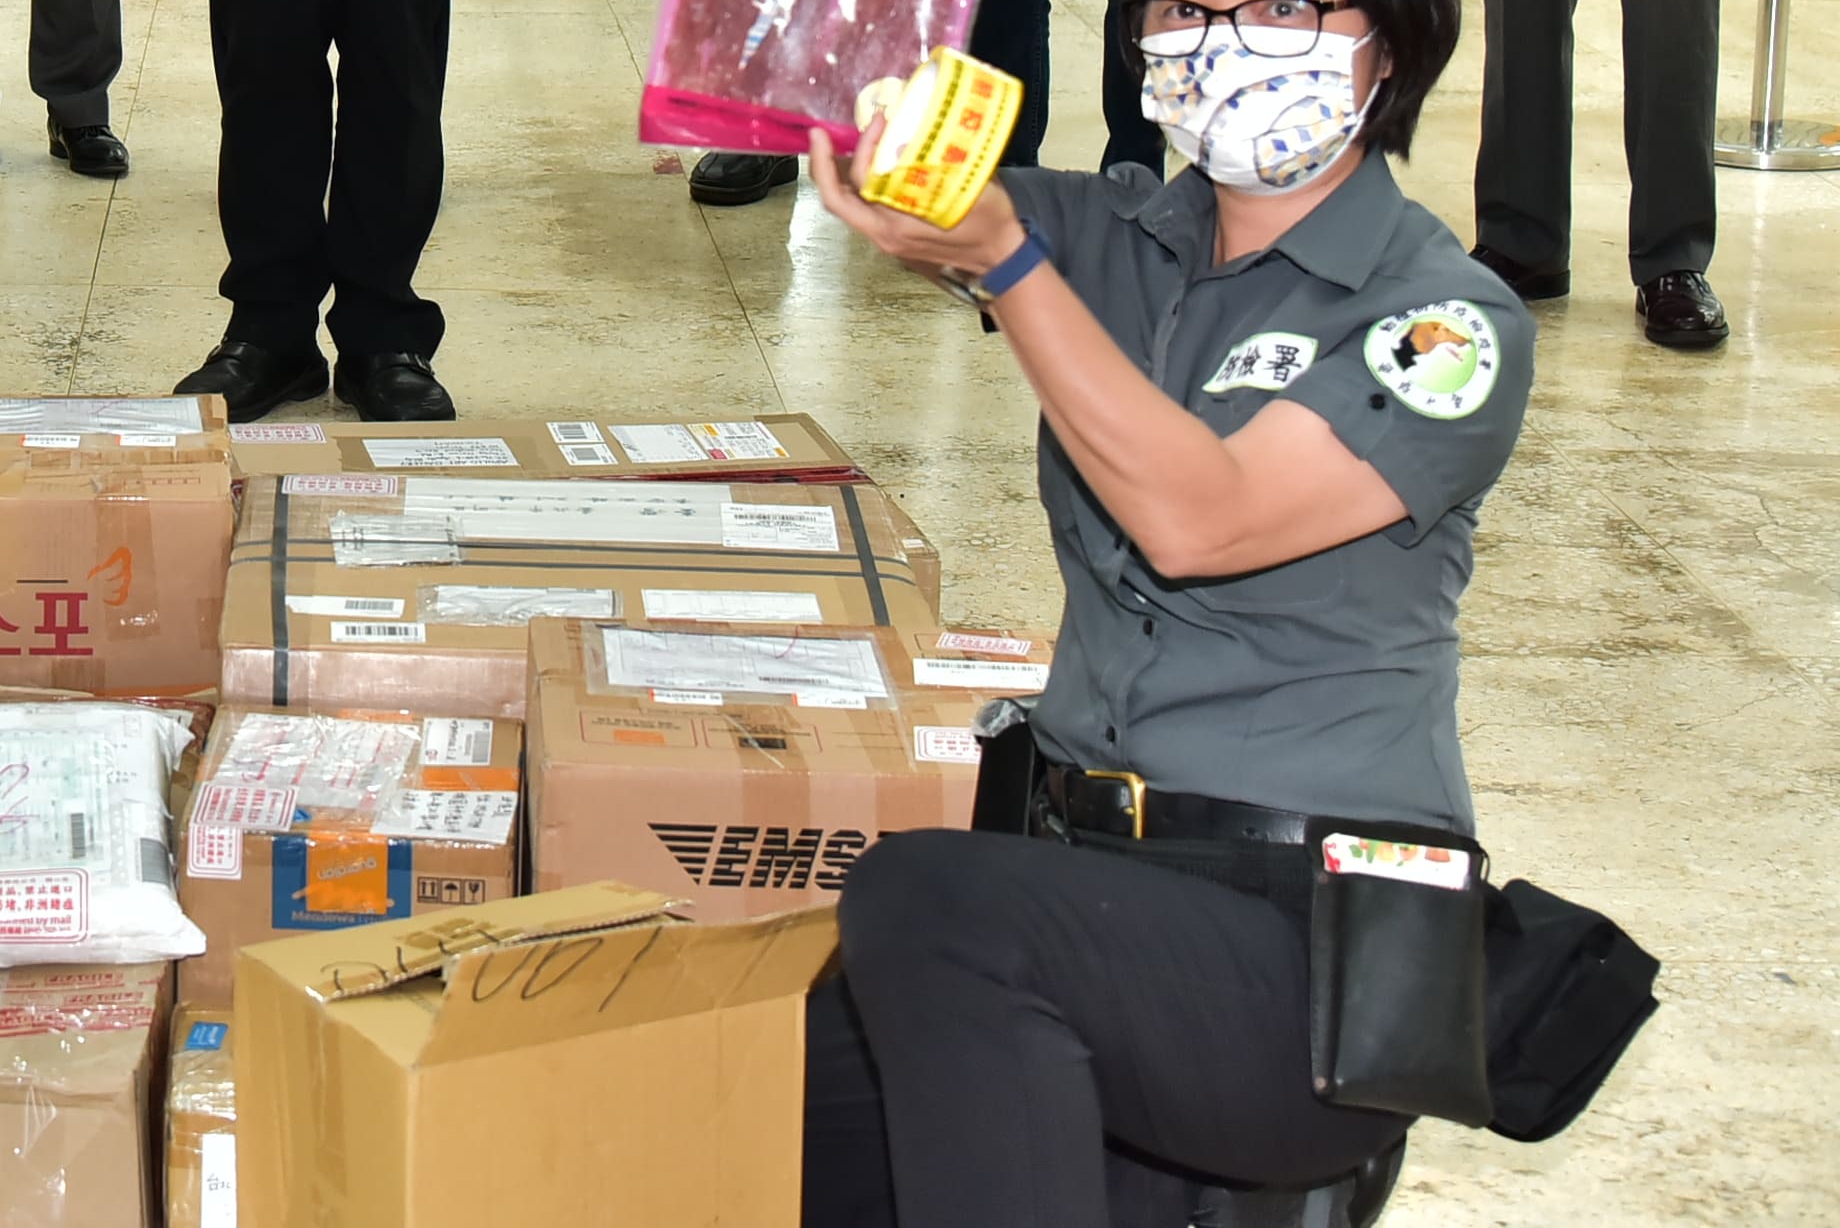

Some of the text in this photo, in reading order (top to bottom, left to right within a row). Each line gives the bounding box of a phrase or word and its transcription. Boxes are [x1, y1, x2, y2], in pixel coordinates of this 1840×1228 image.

[1216, 344, 1302, 382] 防檢署
[709, 825, 865, 890] EMS
